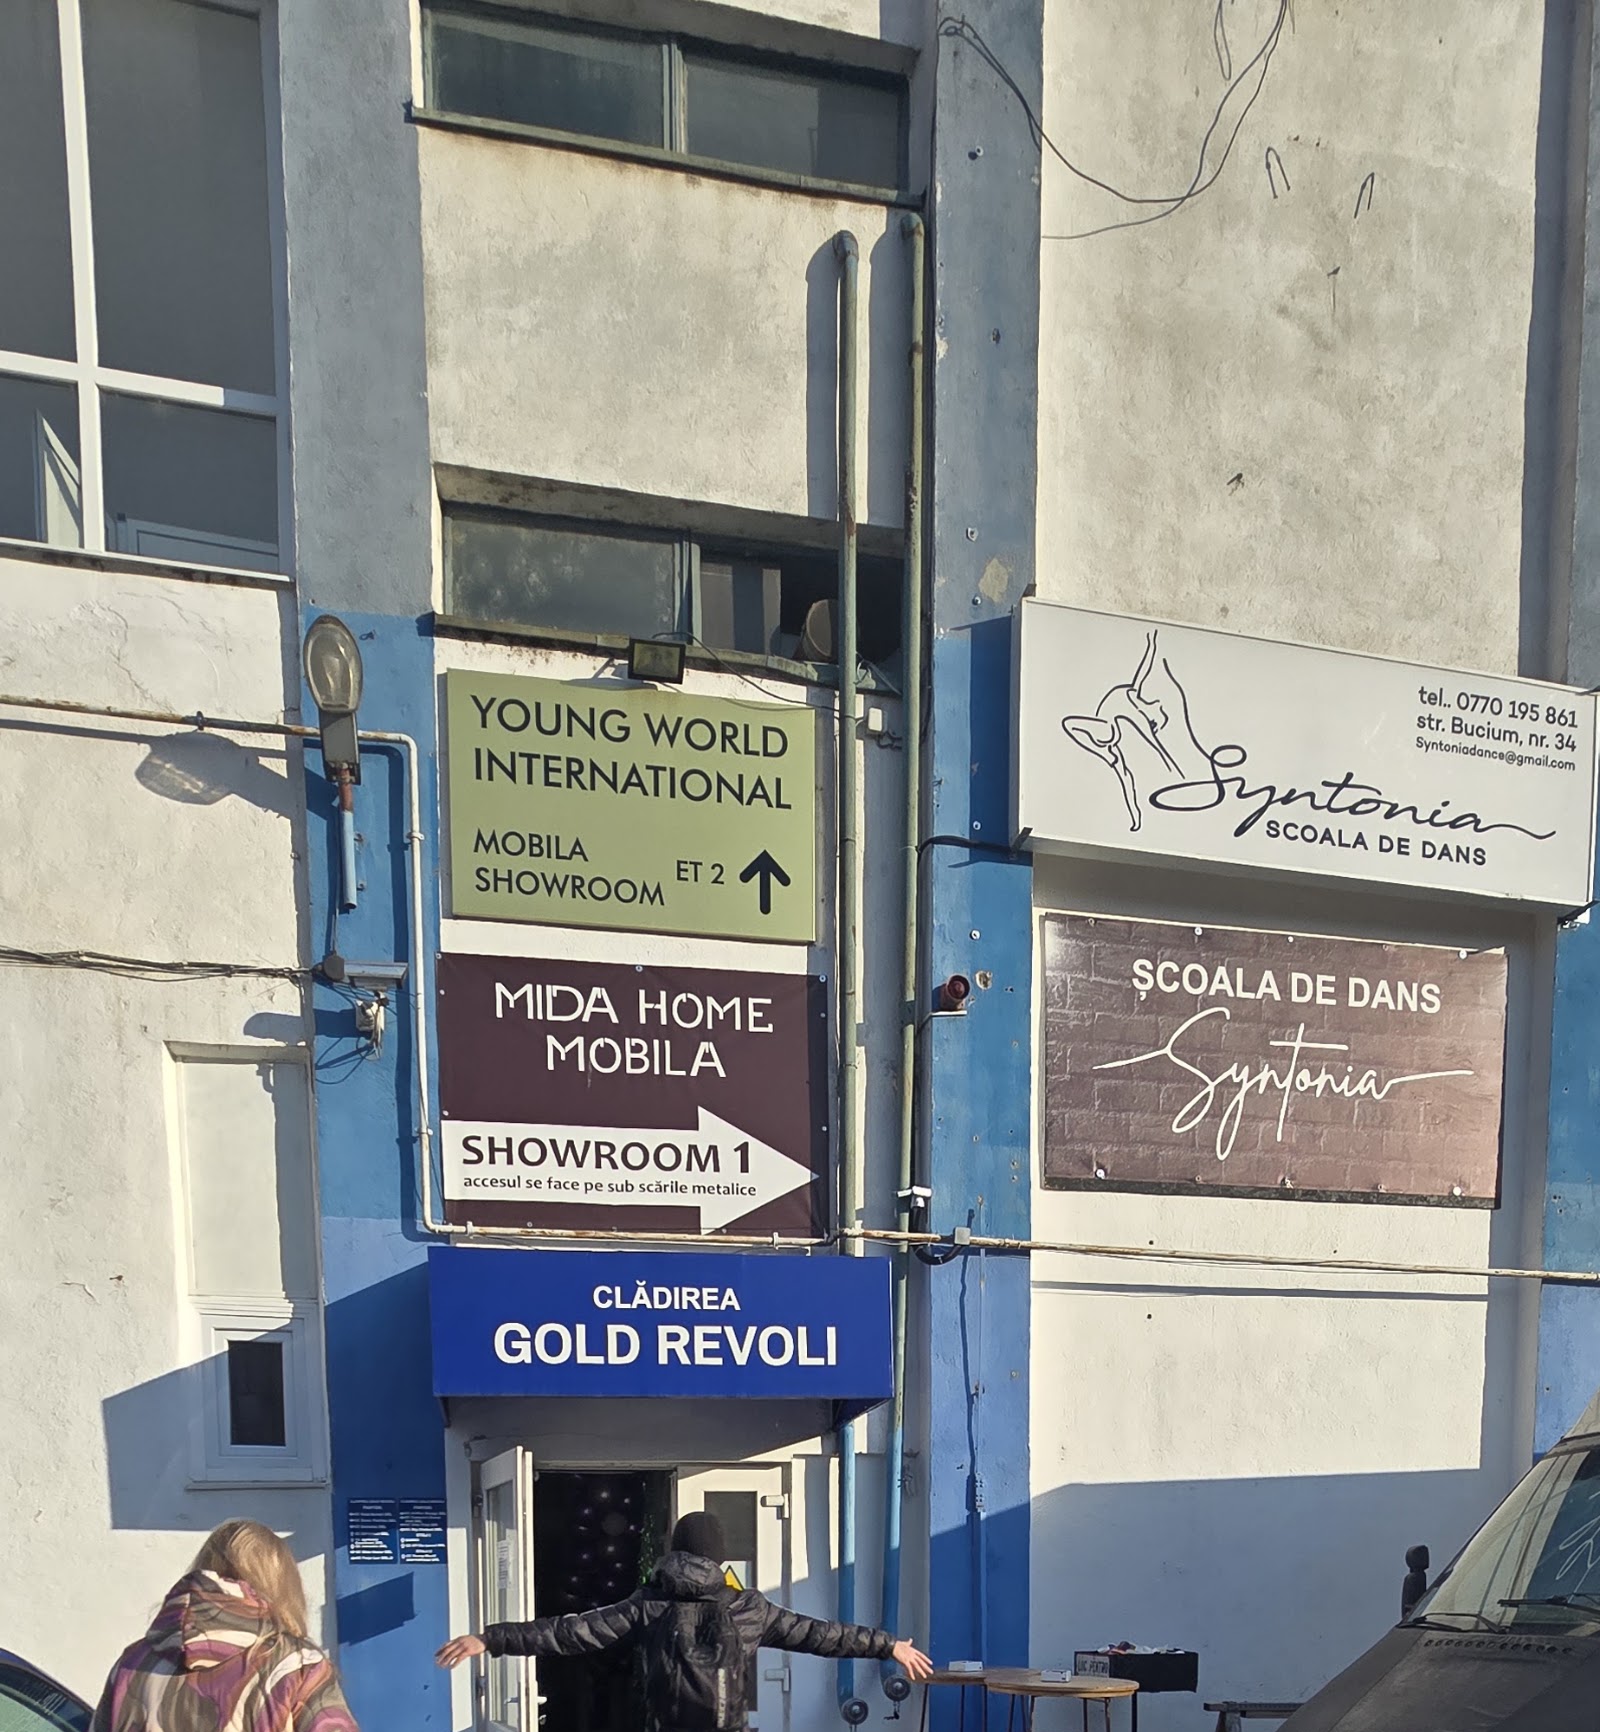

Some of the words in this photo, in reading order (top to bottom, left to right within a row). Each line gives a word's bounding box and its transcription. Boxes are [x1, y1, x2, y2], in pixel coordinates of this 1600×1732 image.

[470, 694, 631, 743] YOUNG
[643, 712, 788, 758] WORLD
[1457, 692, 1503, 716] 0770
[1508, 700, 1540, 722] 195
[1545, 706, 1578, 728] 861
[1416, 713, 1445, 732] str.
[1451, 716, 1523, 746] Bucium,
[1528, 732, 1549, 748] nr.
[1555, 733, 1577, 752] 34
[1416, 736, 1575, 771] Syntoniadance@gmail.com
[475, 747, 792, 810] INTERNATIONAL
[1149, 744, 1557, 837] Syntonia
[473, 828, 589, 862] MOBILA
[1266, 819, 1369, 852] SCOALA
[1379, 836, 1410, 857] DE
[1422, 840, 1487, 867] DANS
[475, 867, 665, 906] SHOWROOM
[677, 859, 702, 883] ET
[711, 863, 725, 885] 2
[1131, 959, 1281, 1001] ȘCOALA
[1291, 972, 1336, 1003] DE
[1348, 977, 1441, 1014] DANS
[495, 982, 619, 1024] MIDA
[639, 989, 774, 1033] HOME
[546, 1034, 726, 1078] MOBILA
[1093, 1007, 1474, 1160] Syntonia
[461, 1135, 721, 1173] SHOWROOM
[733, 1141, 750, 1174] 1
[463, 1175, 521, 1189] accesul
[525, 1179, 542, 1190] se
[547, 1176, 580, 1191] face
[584, 1181, 604, 1195] pe
[607, 1178, 635, 1193] sub
[639, 1179, 688, 1195] scările
[692, 1180, 757, 1196] metalice
[593, 1280, 741, 1311] CLĂDIREA
[493, 1322, 640, 1365] GOLD
[658, 1325, 837, 1366] REVOLI
